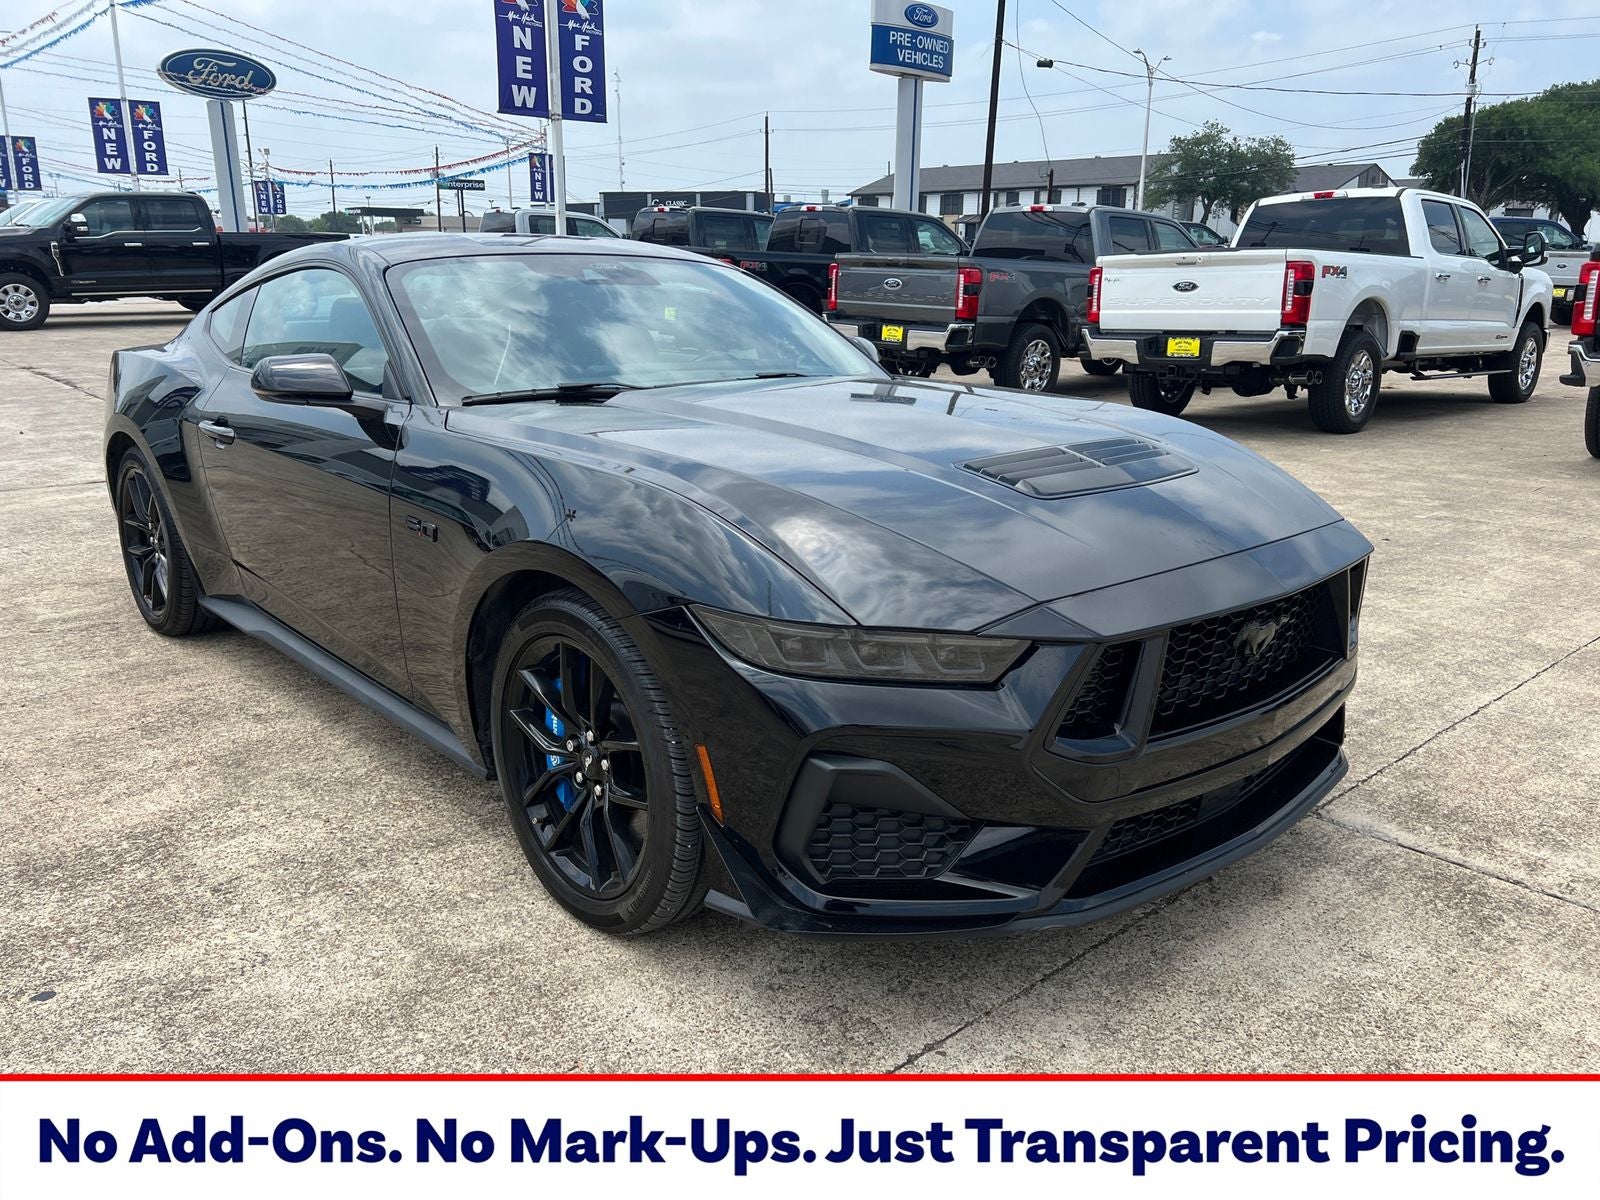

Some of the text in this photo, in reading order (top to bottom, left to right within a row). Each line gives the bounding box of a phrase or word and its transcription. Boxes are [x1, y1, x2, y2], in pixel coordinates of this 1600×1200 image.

[913, 7, 933, 23] Ford
[511, 25, 537, 109] NEW
[897, 48, 944, 69] VEHICLES
[188, 57, 254, 89] Ford
[572, 34, 593, 115] FORD
[102, 127, 121, 170] NEW
[143, 130, 158, 172] FORD
[22, 157, 34, 189] FORD
[534, 172, 543, 200] NEW
[260, 193, 268, 213] NEW
[740, 260, 768, 270] FX4
[990, 271, 1017, 281] FX4
[1322, 265, 1347, 278] FX4
